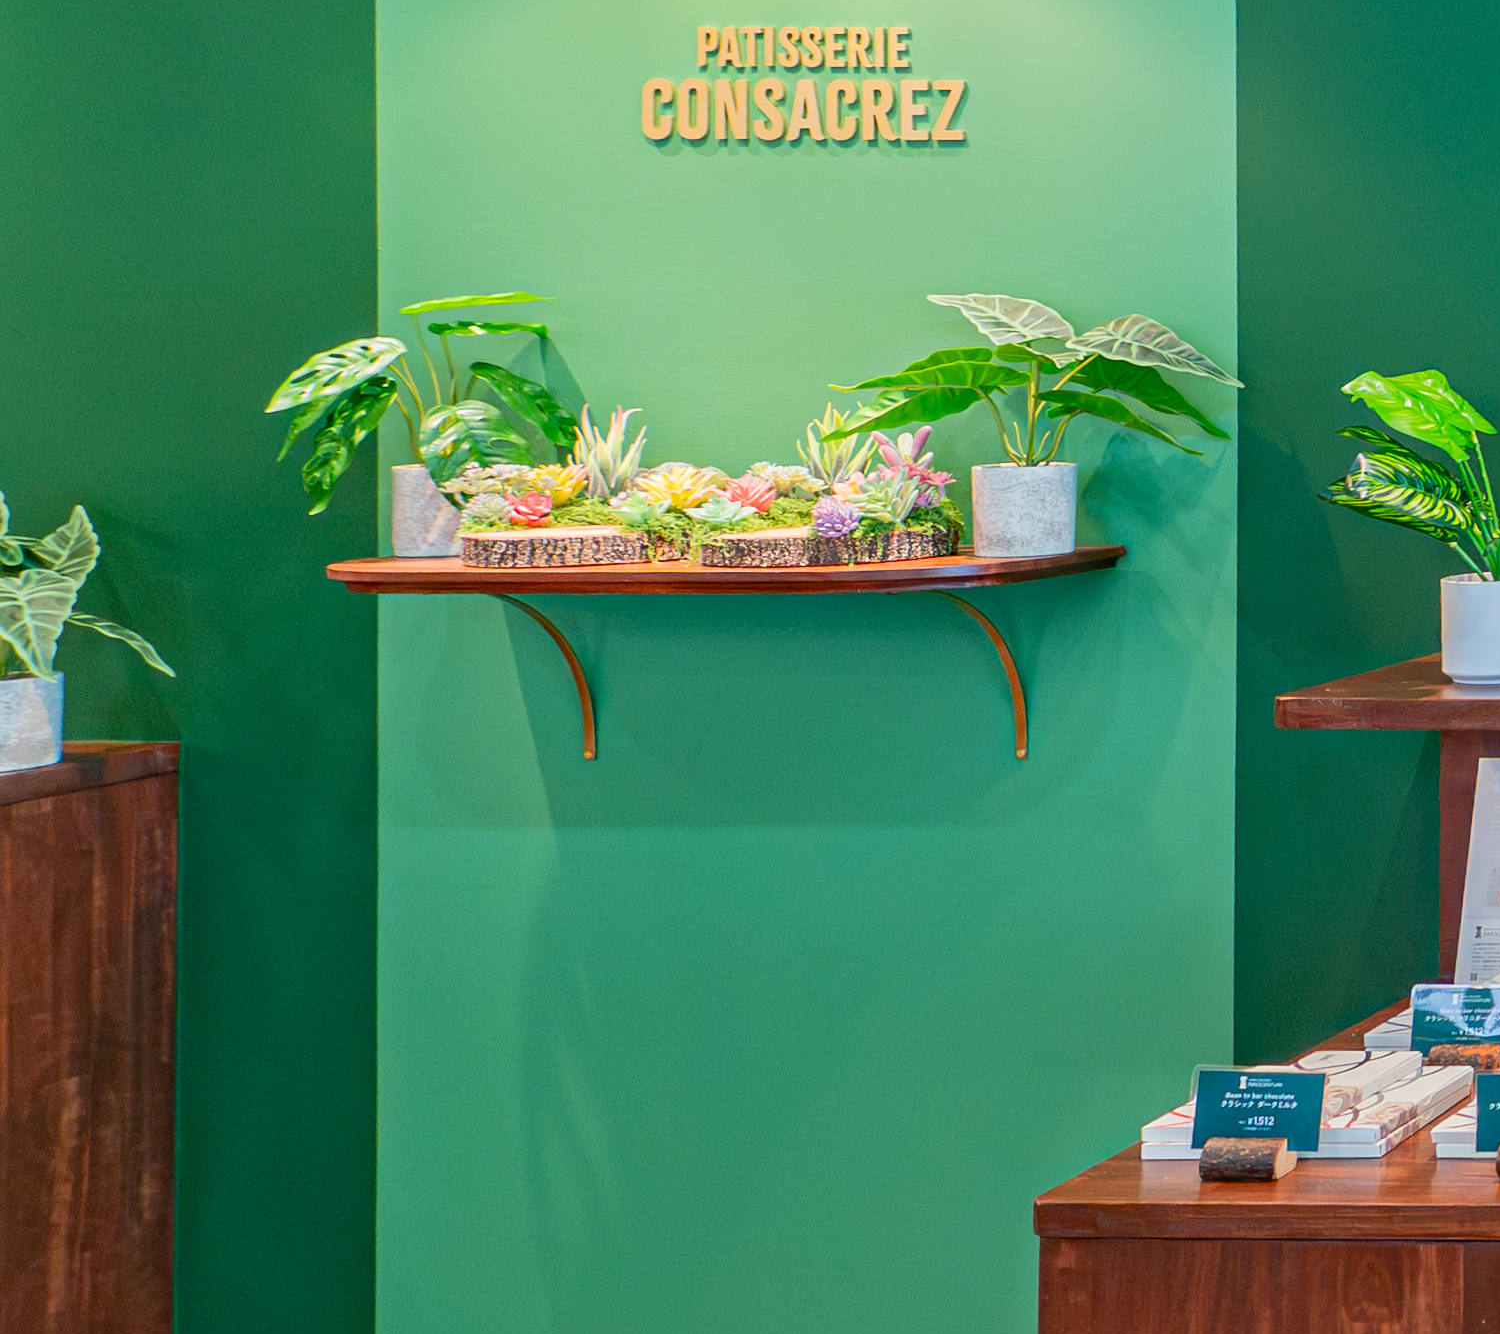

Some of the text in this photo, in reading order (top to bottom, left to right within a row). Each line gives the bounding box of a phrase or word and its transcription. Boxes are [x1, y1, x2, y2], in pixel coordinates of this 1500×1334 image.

[696, 26, 911, 69] PATISSERIE
[641, 78, 967, 142] CONSACREZ
[1248, 1116, 1274, 1126] ¥1,512
